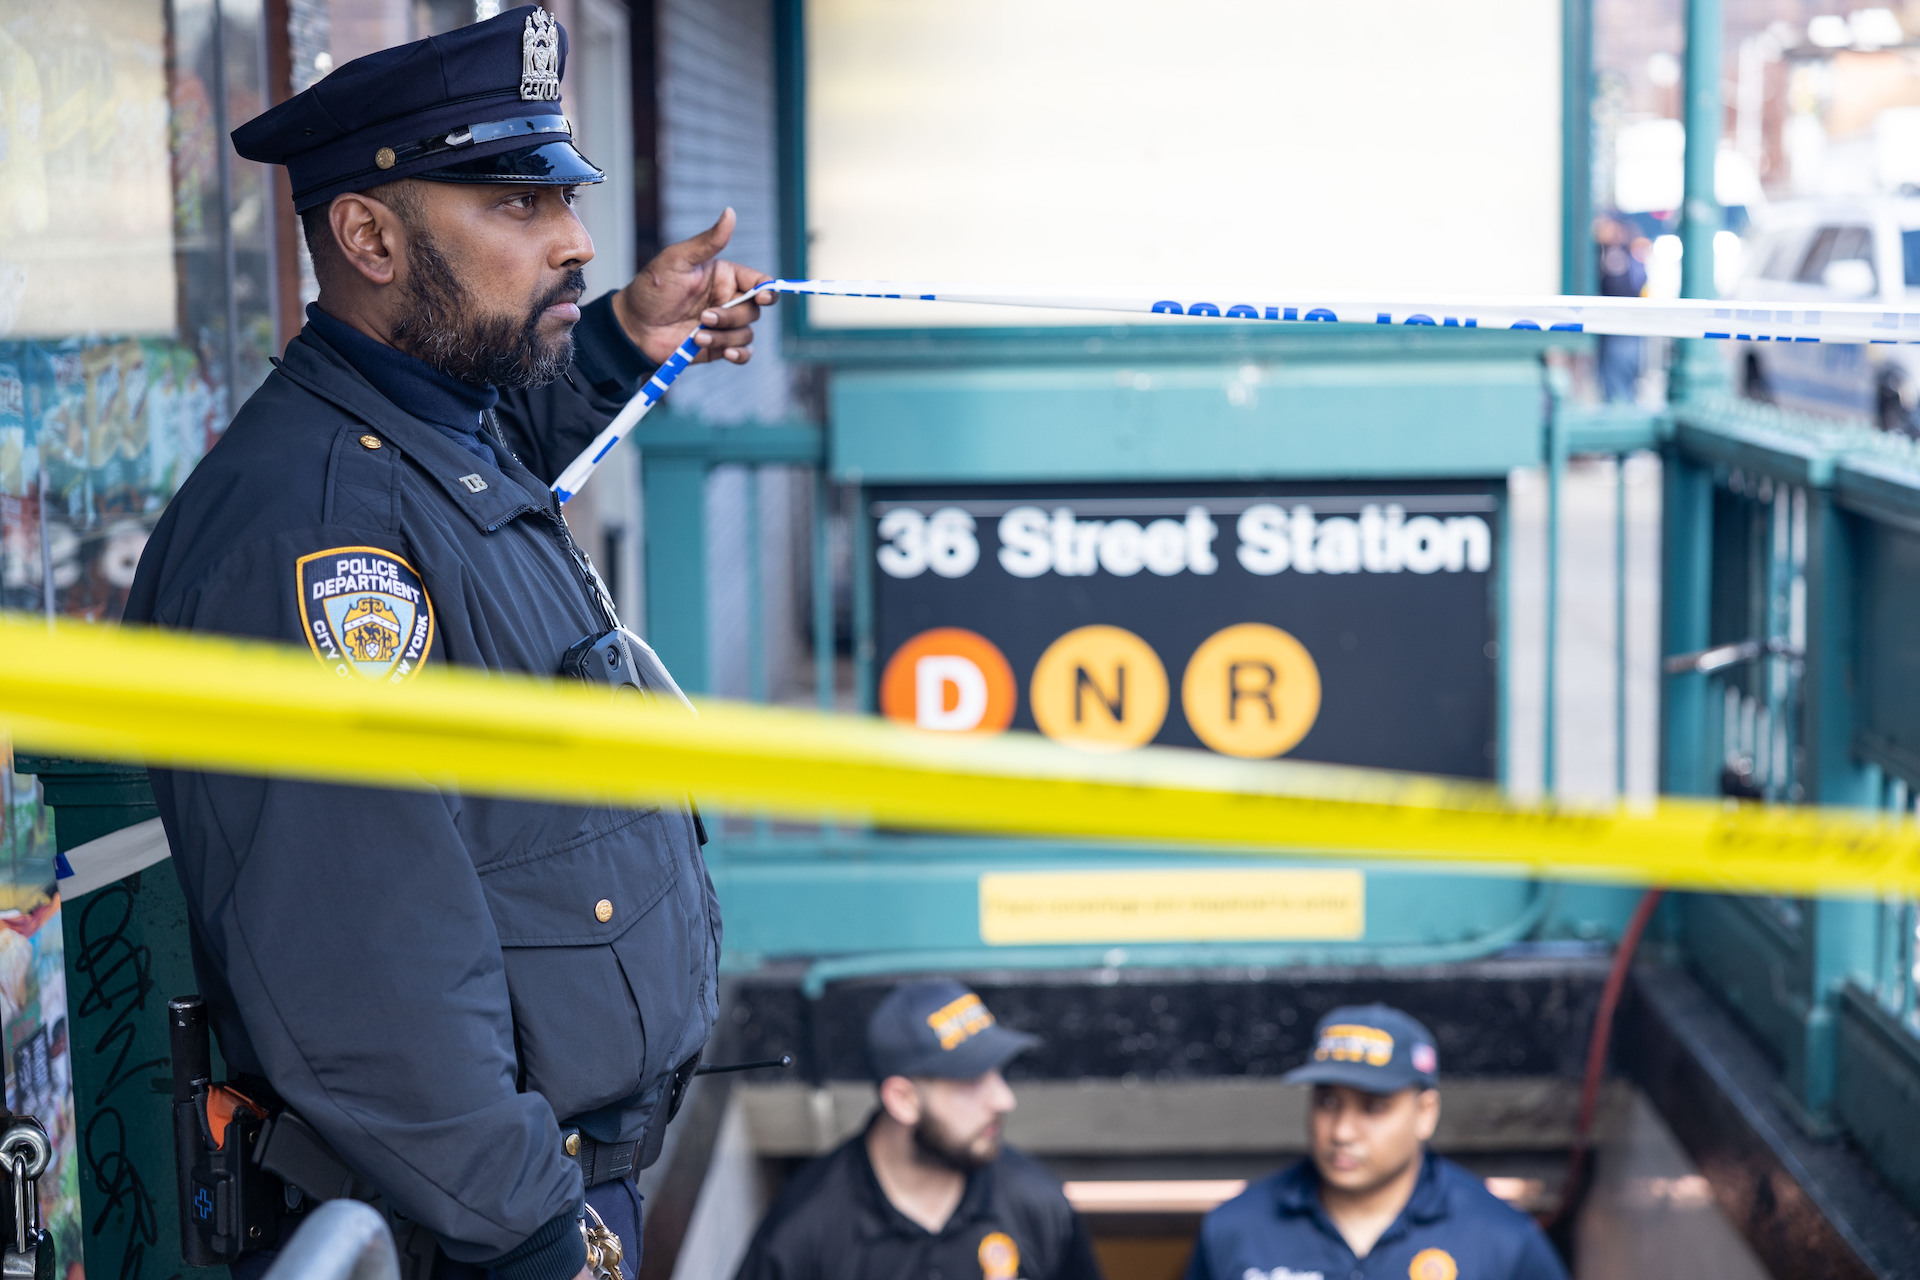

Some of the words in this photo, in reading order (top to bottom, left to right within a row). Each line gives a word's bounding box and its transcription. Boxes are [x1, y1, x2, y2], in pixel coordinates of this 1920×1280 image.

[522, 79, 559, 101] 23700
[876, 506, 980, 579] 36
[997, 505, 1219, 579] Street
[1236, 503, 1491, 576] Station
[312, 574, 420, 604] DEPARTMENT
[336, 558, 399, 580] POLICE
[312, 619, 340, 660] CITY
[388, 658, 411, 686] EW
[405, 614, 428, 659] YORK
[914, 654, 989, 732] D
[1073, 662, 1126, 725] N
[1227, 660, 1277, 723] R
